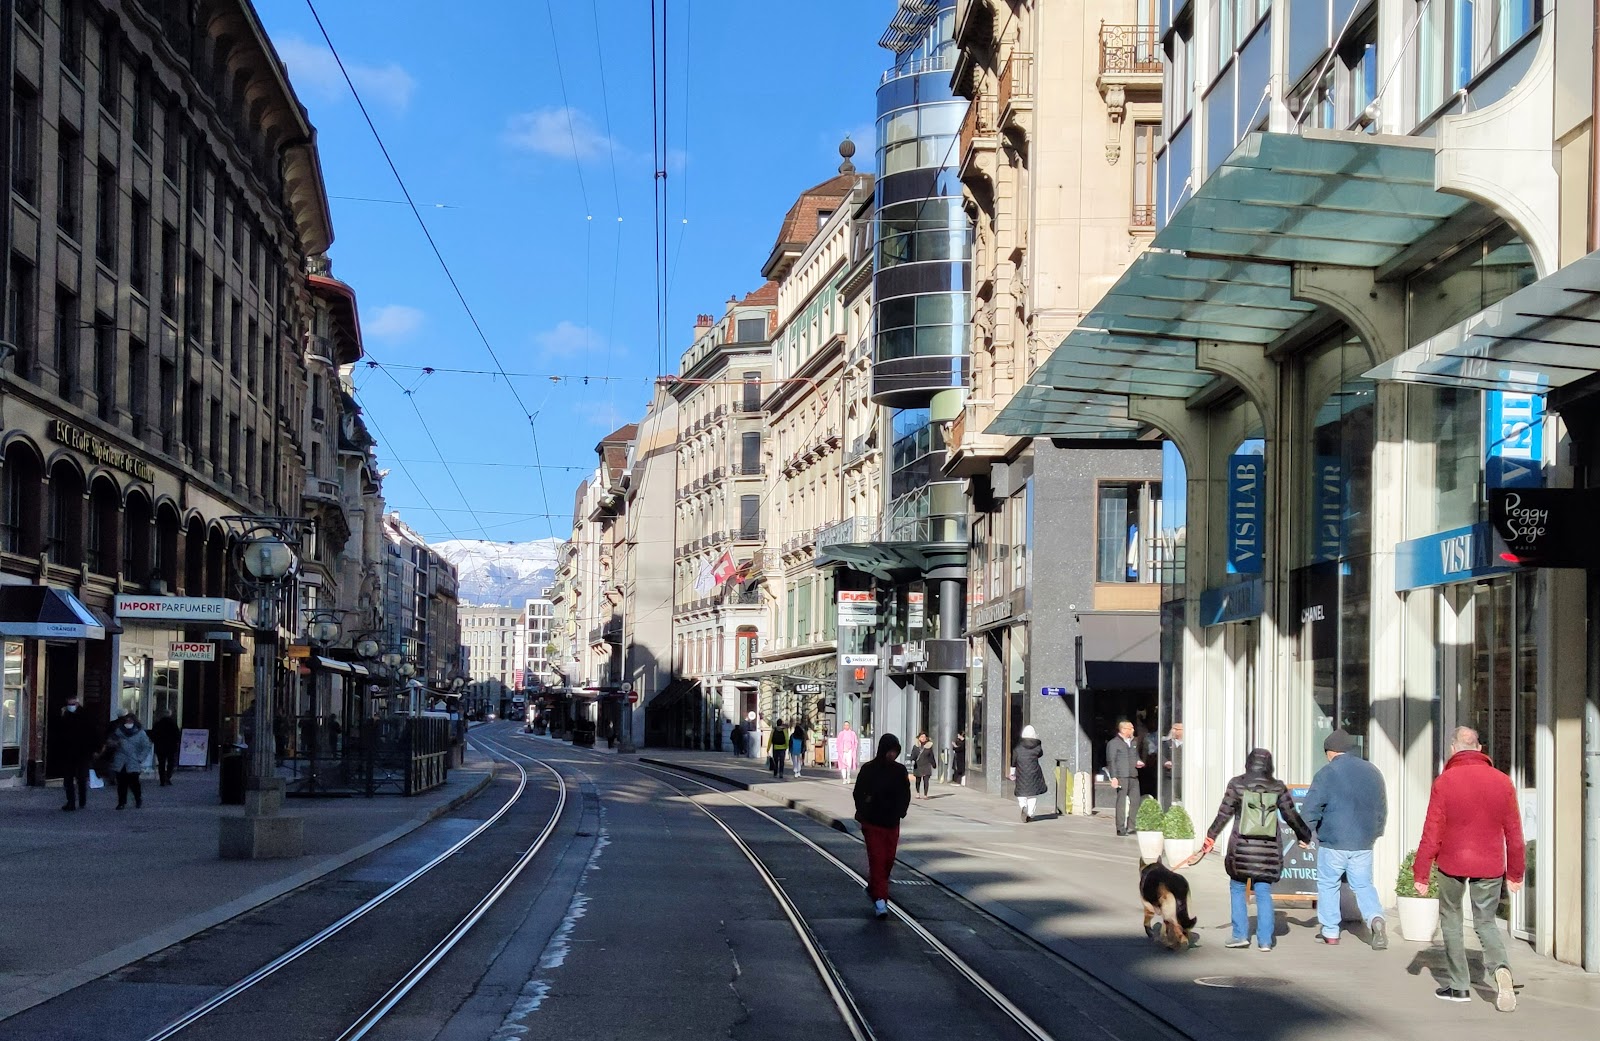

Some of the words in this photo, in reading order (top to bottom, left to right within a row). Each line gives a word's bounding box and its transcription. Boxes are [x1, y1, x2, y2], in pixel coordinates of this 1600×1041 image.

[57, 420, 71, 445] ESC
[126, 454, 133, 473] de
[1235, 463, 1257, 562] VISILAB
[1505, 492, 1549, 525] Peggy
[1503, 518, 1546, 543] Sage
[1301, 604, 1326, 624] CHANEL
[171, 643, 212, 653] IMPORT
[171, 652, 212, 660] PARFUMERIE
[796, 684, 820, 692] LUSH
[1303, 851, 1315, 862] LA
